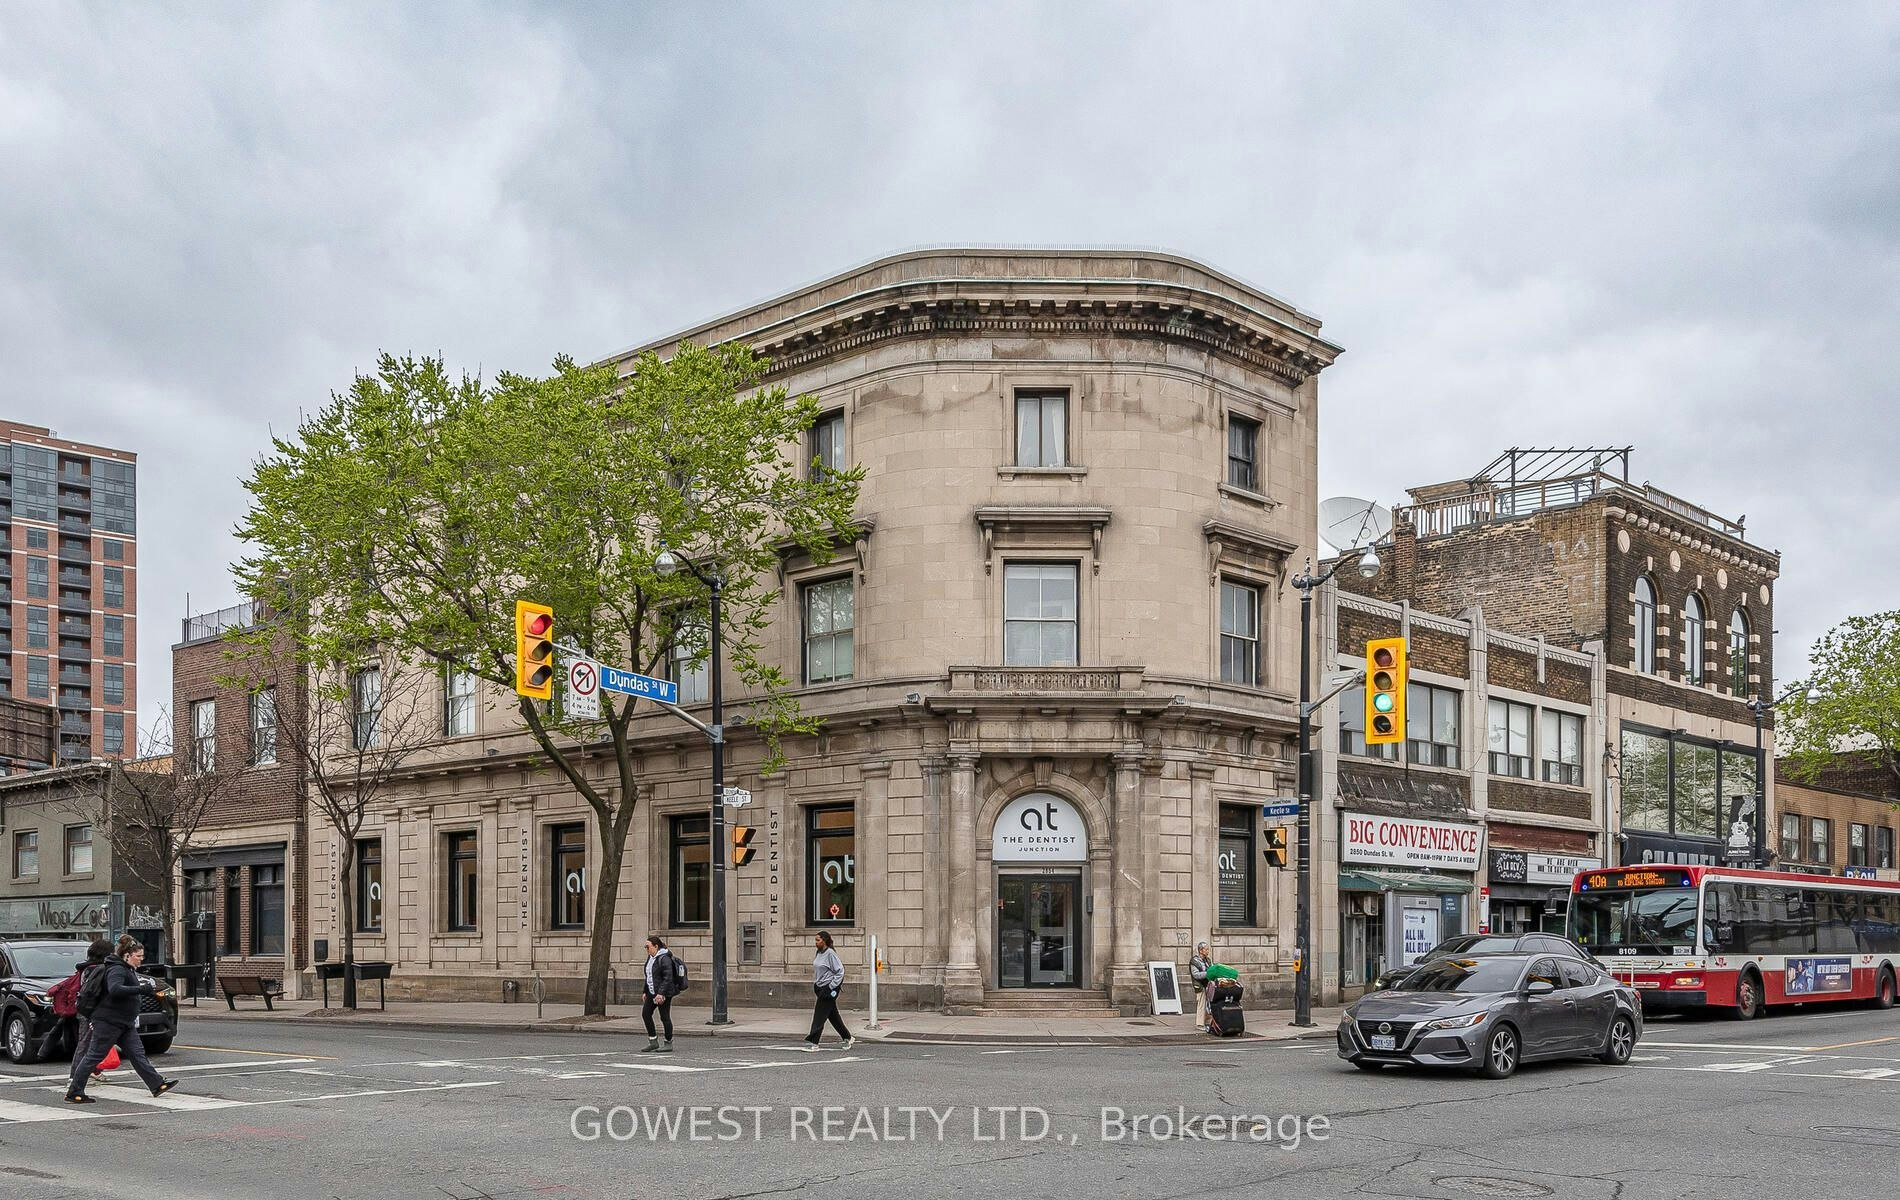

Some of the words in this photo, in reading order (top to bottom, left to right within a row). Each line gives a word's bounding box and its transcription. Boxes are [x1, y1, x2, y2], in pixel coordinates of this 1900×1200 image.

[609, 671, 649, 693] Dundas
[652, 680, 658, 688] St
[660, 682, 668, 696] W
[1020, 803, 1058, 830] at
[1350, 820, 1374, 845] BIG
[1380, 823, 1477, 853] CONVENIENCE
[1219, 850, 1236, 870] at
[1589, 875, 1607, 887] 40A
[1405, 930, 1416, 940] ALL
[1405, 943, 1416, 953] ALL
